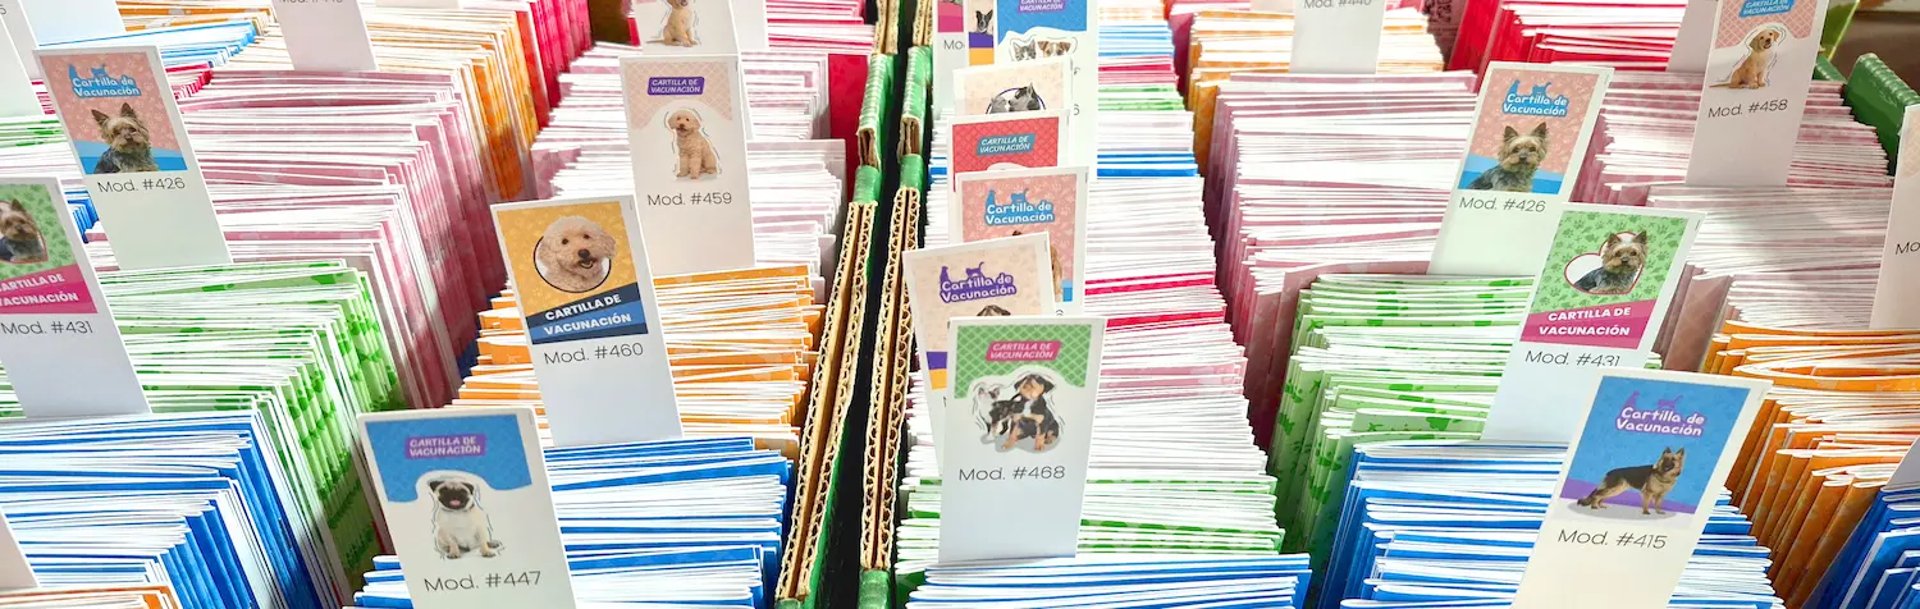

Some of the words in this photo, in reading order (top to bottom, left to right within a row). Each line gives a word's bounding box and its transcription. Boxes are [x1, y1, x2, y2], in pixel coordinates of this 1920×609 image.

[72, 77, 118, 88] Cartilla
[121, 77, 135, 86] de
[650, 85, 701, 93] VACUNACIÓN
[73, 86, 140, 97] Vacunación
[1506, 93, 1550, 104] Cartilla
[1554, 95, 1568, 106] de
[1503, 103, 1566, 116] Vacunación
[1707, 103, 1743, 118] Mod.
[1747, 98, 1788, 114] #458
[979, 142, 1031, 154] VACUNACIÓN
[981, 136, 1017, 146] CARTILLA
[1018, 135, 1030, 143] DE
[97, 179, 139, 193] Mod.
[142, 177, 186, 191] #426
[647, 193, 686, 206] Mod.
[690, 192, 732, 205] #459
[1458, 196, 1497, 210] Mod.
[1503, 199, 1546, 213] #426
[986, 202, 1034, 214] Cartilla
[1037, 201, 1052, 211] de
[985, 212, 1054, 225] Vacunación
[0, 276, 50, 291] ARTILLA
[47, 273, 65, 284] DE
[941, 275, 993, 291] Cartilla
[997, 274, 1012, 285] de
[941, 285, 1016, 303] Vacunación
[544, 299, 604, 320] CARTILLA
[604, 293, 622, 306] DE
[1548, 308, 1611, 322] CARTILLA
[1613, 307, 1632, 317] DE
[0, 321, 47, 335] Mod.
[50, 320, 93, 334] #431
[544, 312, 632, 335] VACUNACIÓN
[1538, 324, 1631, 336] VACUNACIÓN
[543, 347, 590, 365] Mod.
[594, 342, 644, 359] #460
[992, 342, 1037, 351] CARTILLA
[1040, 342, 1052, 350] DE
[990, 350, 1054, 359] VACUNACIÓN
[1524, 350, 1569, 365] Mod.
[1621, 407, 1681, 423] Cartilla
[1686, 411, 1705, 425] de
[1616, 418, 1702, 437] Vacunación
[409, 436, 461, 448] CARTILLA
[462, 436, 477, 445] DE
[409, 445, 481, 457] VACUNACIÓN
[958, 467, 1006, 481] Mod.
[1012, 465, 1066, 480] #468
[1557, 528, 1608, 546] Mod.
[1616, 531, 1668, 549] #415
[423, 573, 479, 592] Mod.
[485, 570, 541, 588] #447
